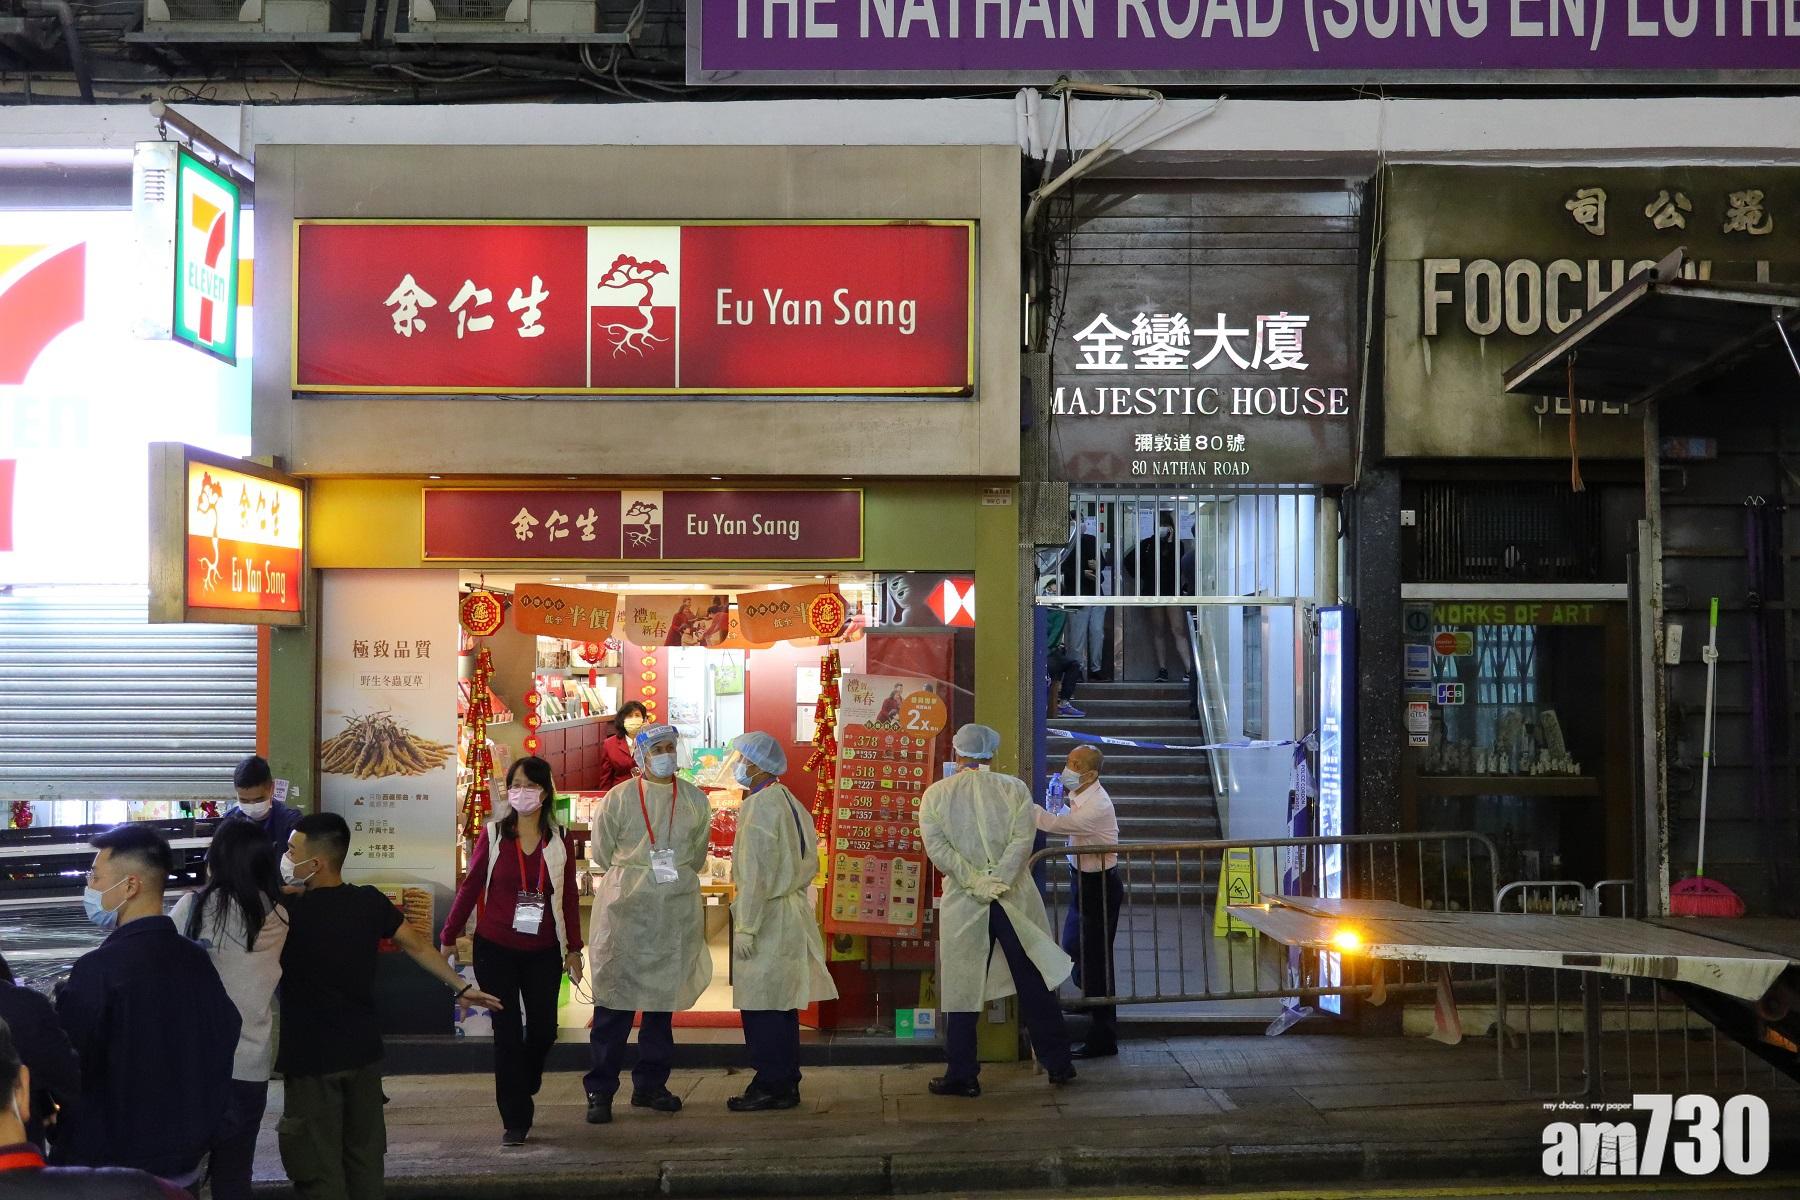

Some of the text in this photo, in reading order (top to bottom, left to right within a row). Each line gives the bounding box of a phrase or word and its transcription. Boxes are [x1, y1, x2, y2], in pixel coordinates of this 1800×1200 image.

[382, 273, 550, 339] 余仁生
[716, 288, 917, 335] Eu Yan Sang
[1072, 311, 1311, 371] 金鑾大廈
[1050, 387, 1349, 416] MAJESTIC HOUSE
[1132, 460, 1250, 476] 80 NATHAN ROAD
[510, 507, 599, 542] 余仁生
[687, 513, 801, 541] Eu Yan Sang
[231, 556, 286, 604] Eu Yan Sang
[1515, 604, 1543, 624] OF
[1552, 604, 1594, 624] ART
[352, 639, 432, 659] 極致品質
[360, 675, 423, 687] 野生冬蟲夏草
[1439, 689, 1463, 698] JCB
